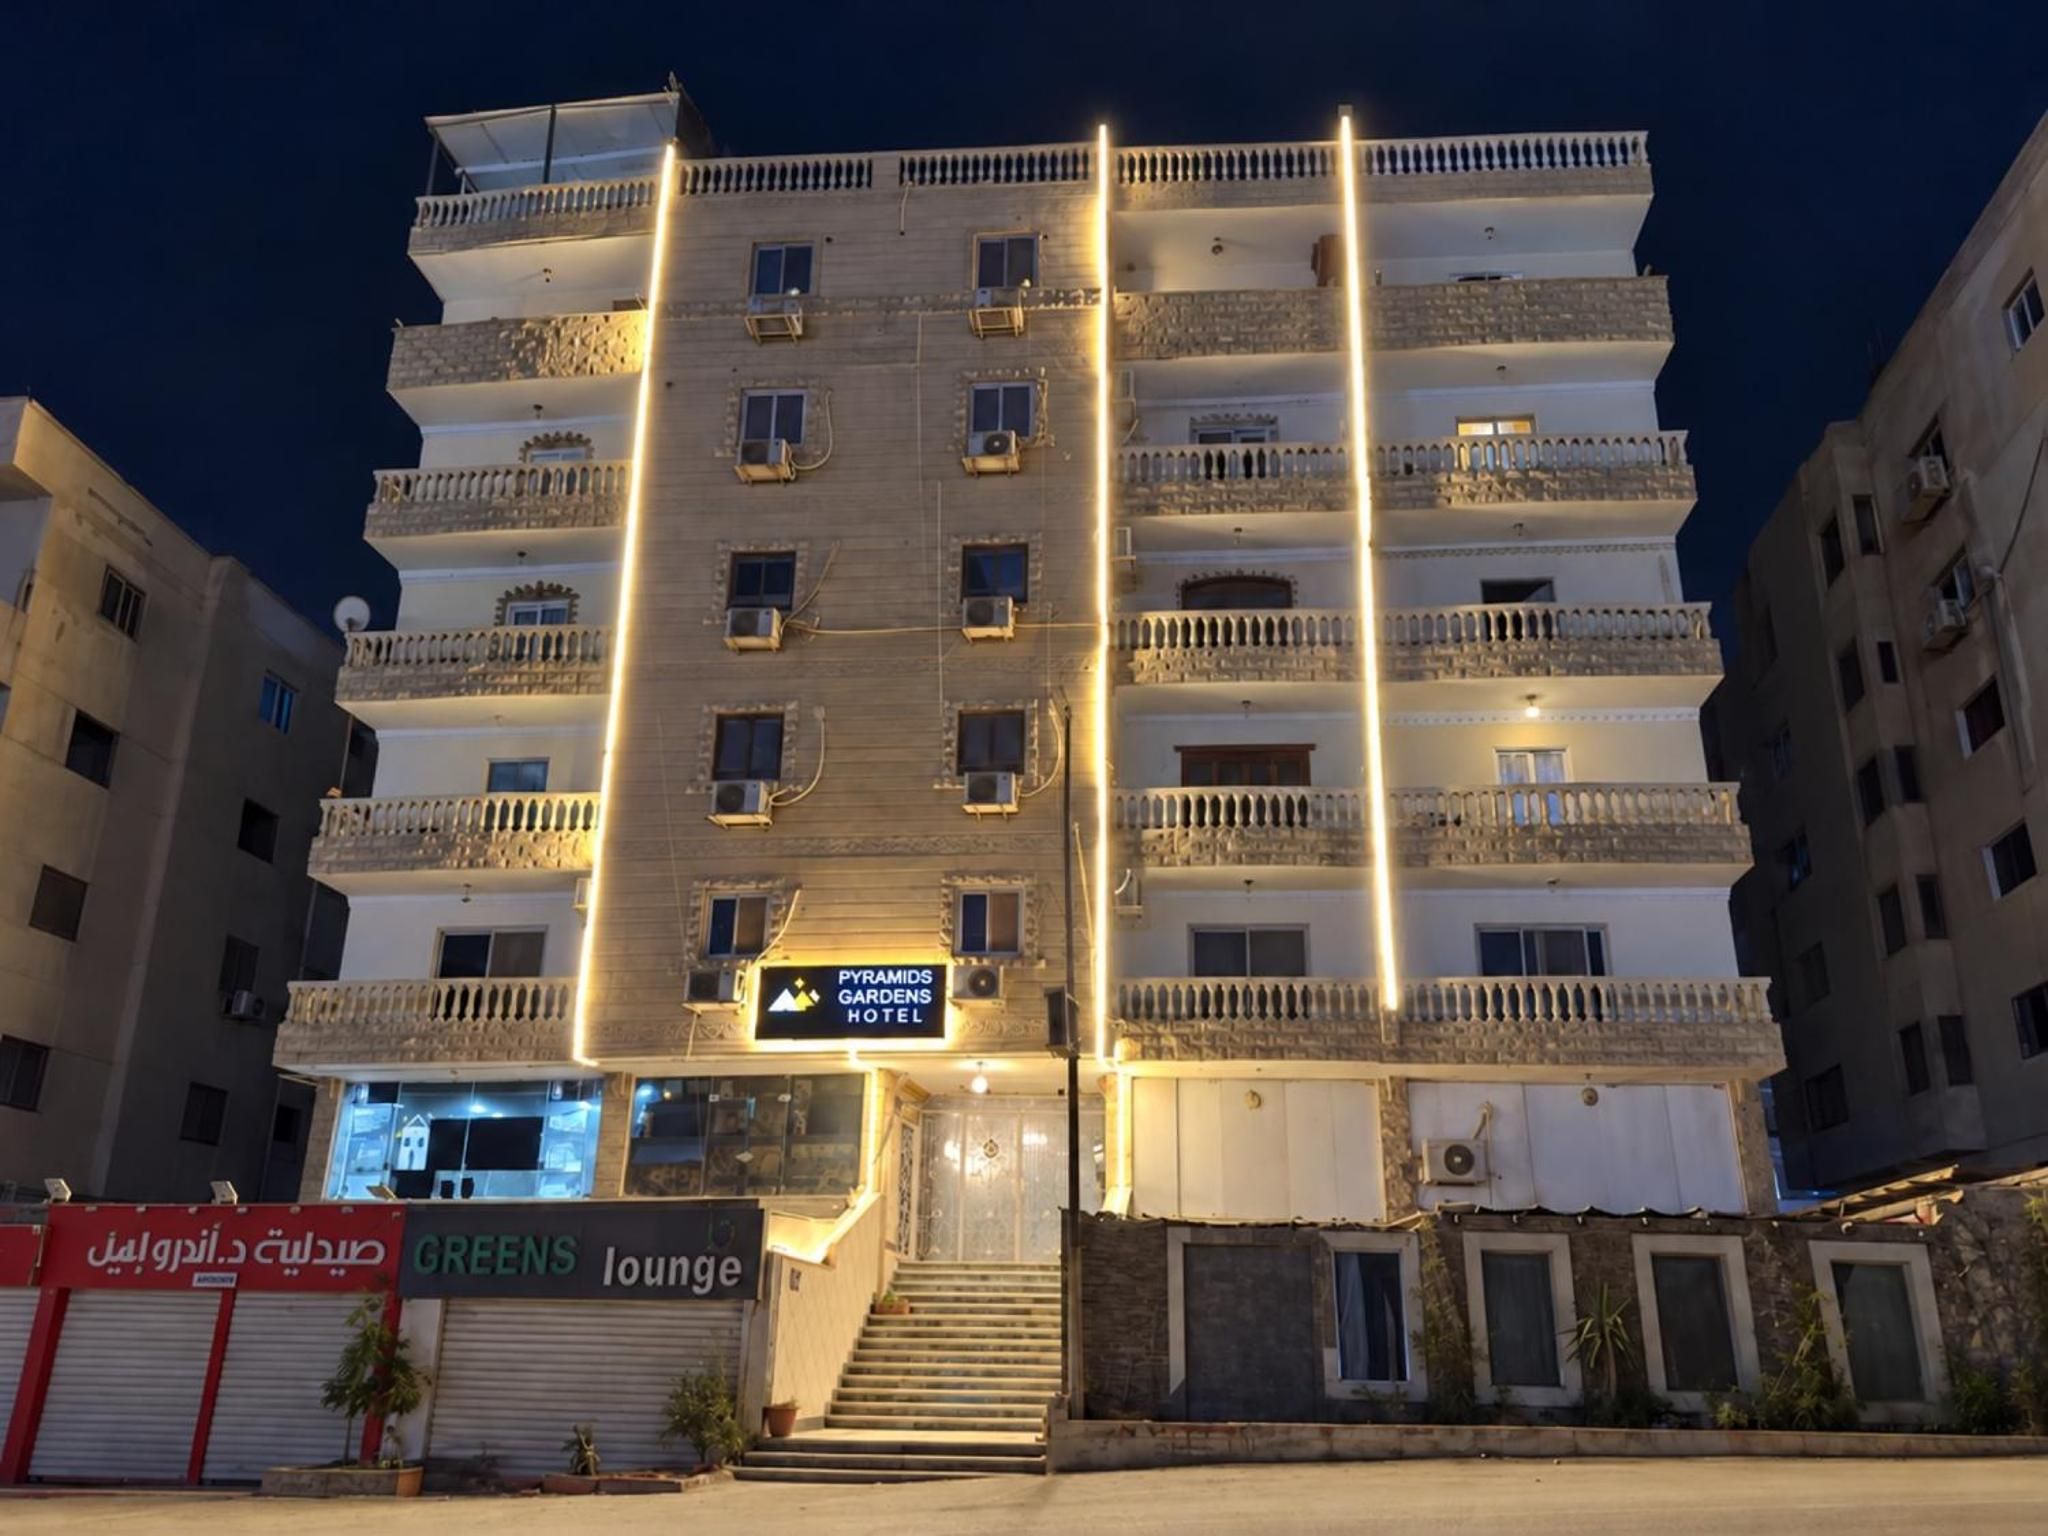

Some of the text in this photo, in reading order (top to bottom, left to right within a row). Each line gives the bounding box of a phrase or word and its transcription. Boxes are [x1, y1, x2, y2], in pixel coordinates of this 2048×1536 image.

[838, 969, 933, 985] PYRAMIDS
[838, 988, 932, 1005] GARDENS
[848, 1008, 923, 1023] HOTEL
[253, 1228, 386, 1277] صيدلية
[412, 1233, 743, 1295] GREENS lounge
